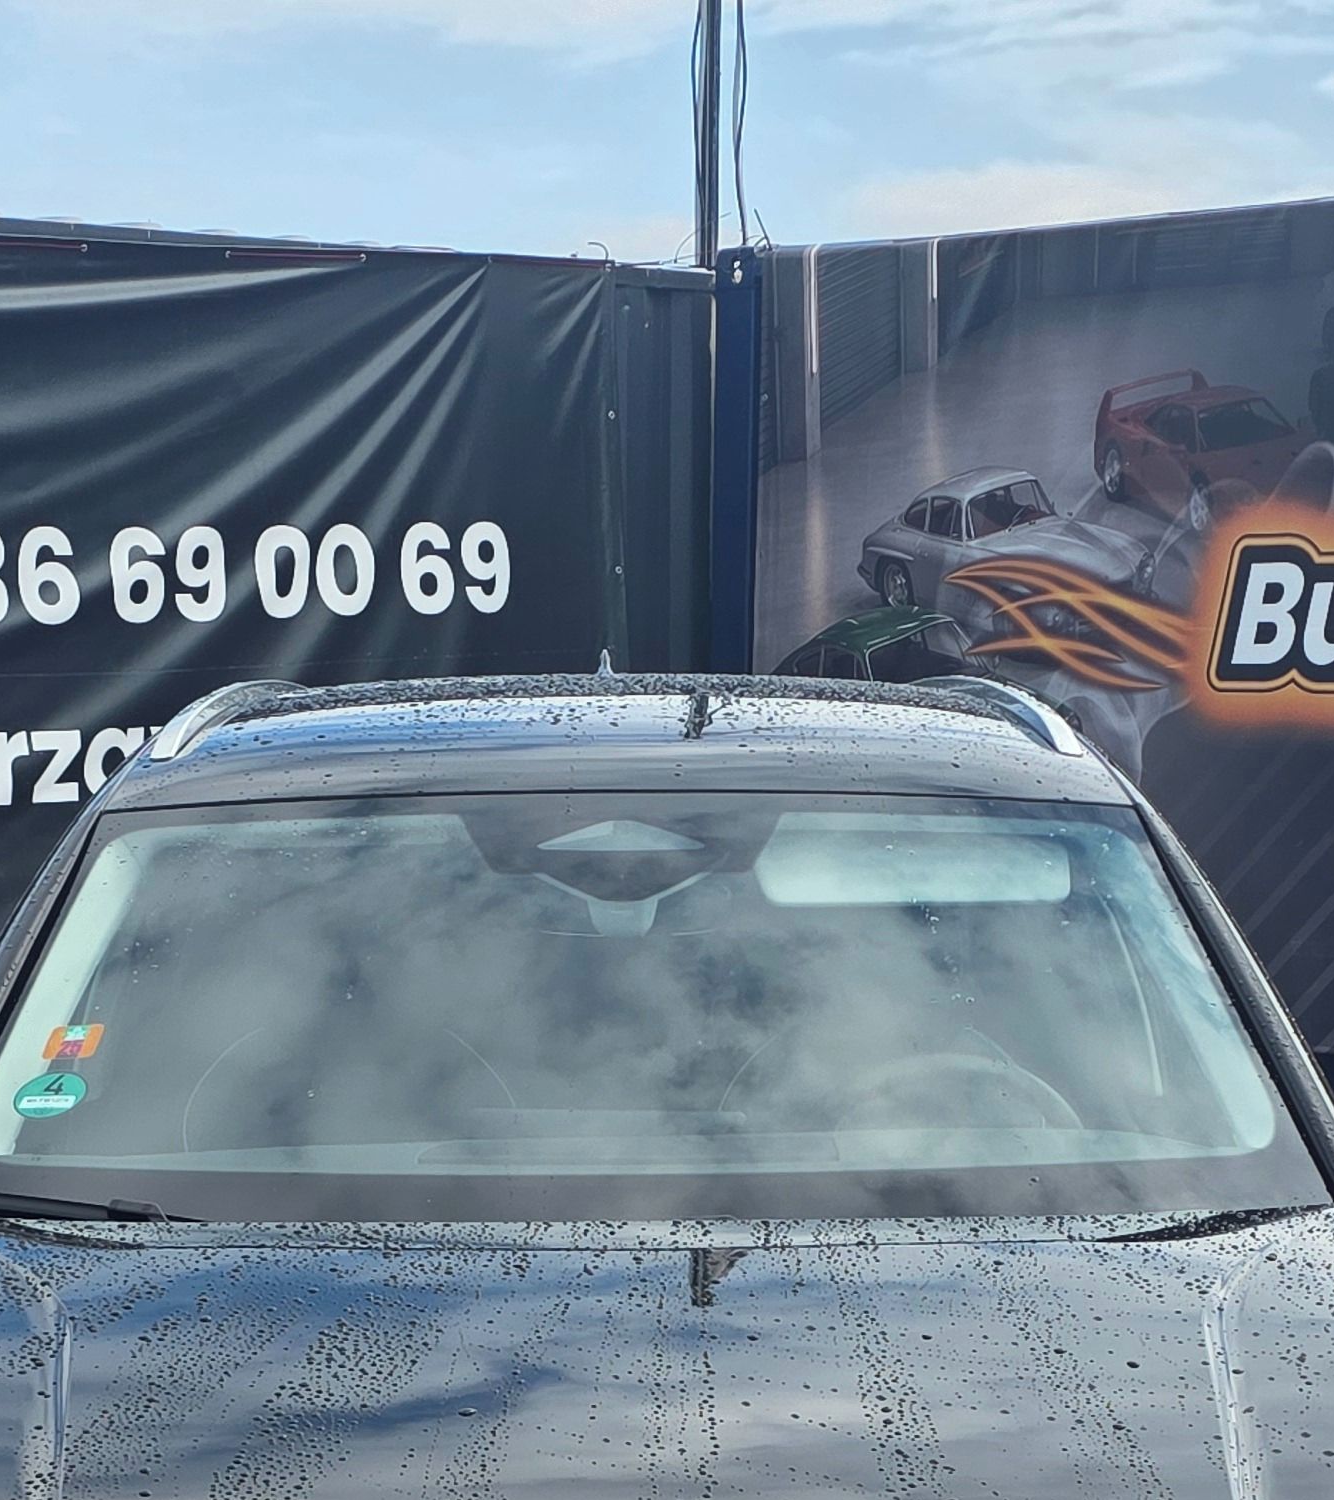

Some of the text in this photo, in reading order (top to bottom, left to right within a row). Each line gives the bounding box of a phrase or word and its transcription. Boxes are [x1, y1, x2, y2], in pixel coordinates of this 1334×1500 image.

[110, 526, 226, 623] 69
[255, 523, 375, 619] 00
[400, 521, 511, 615] 69
[43, 1074, 65, 1095] 4
